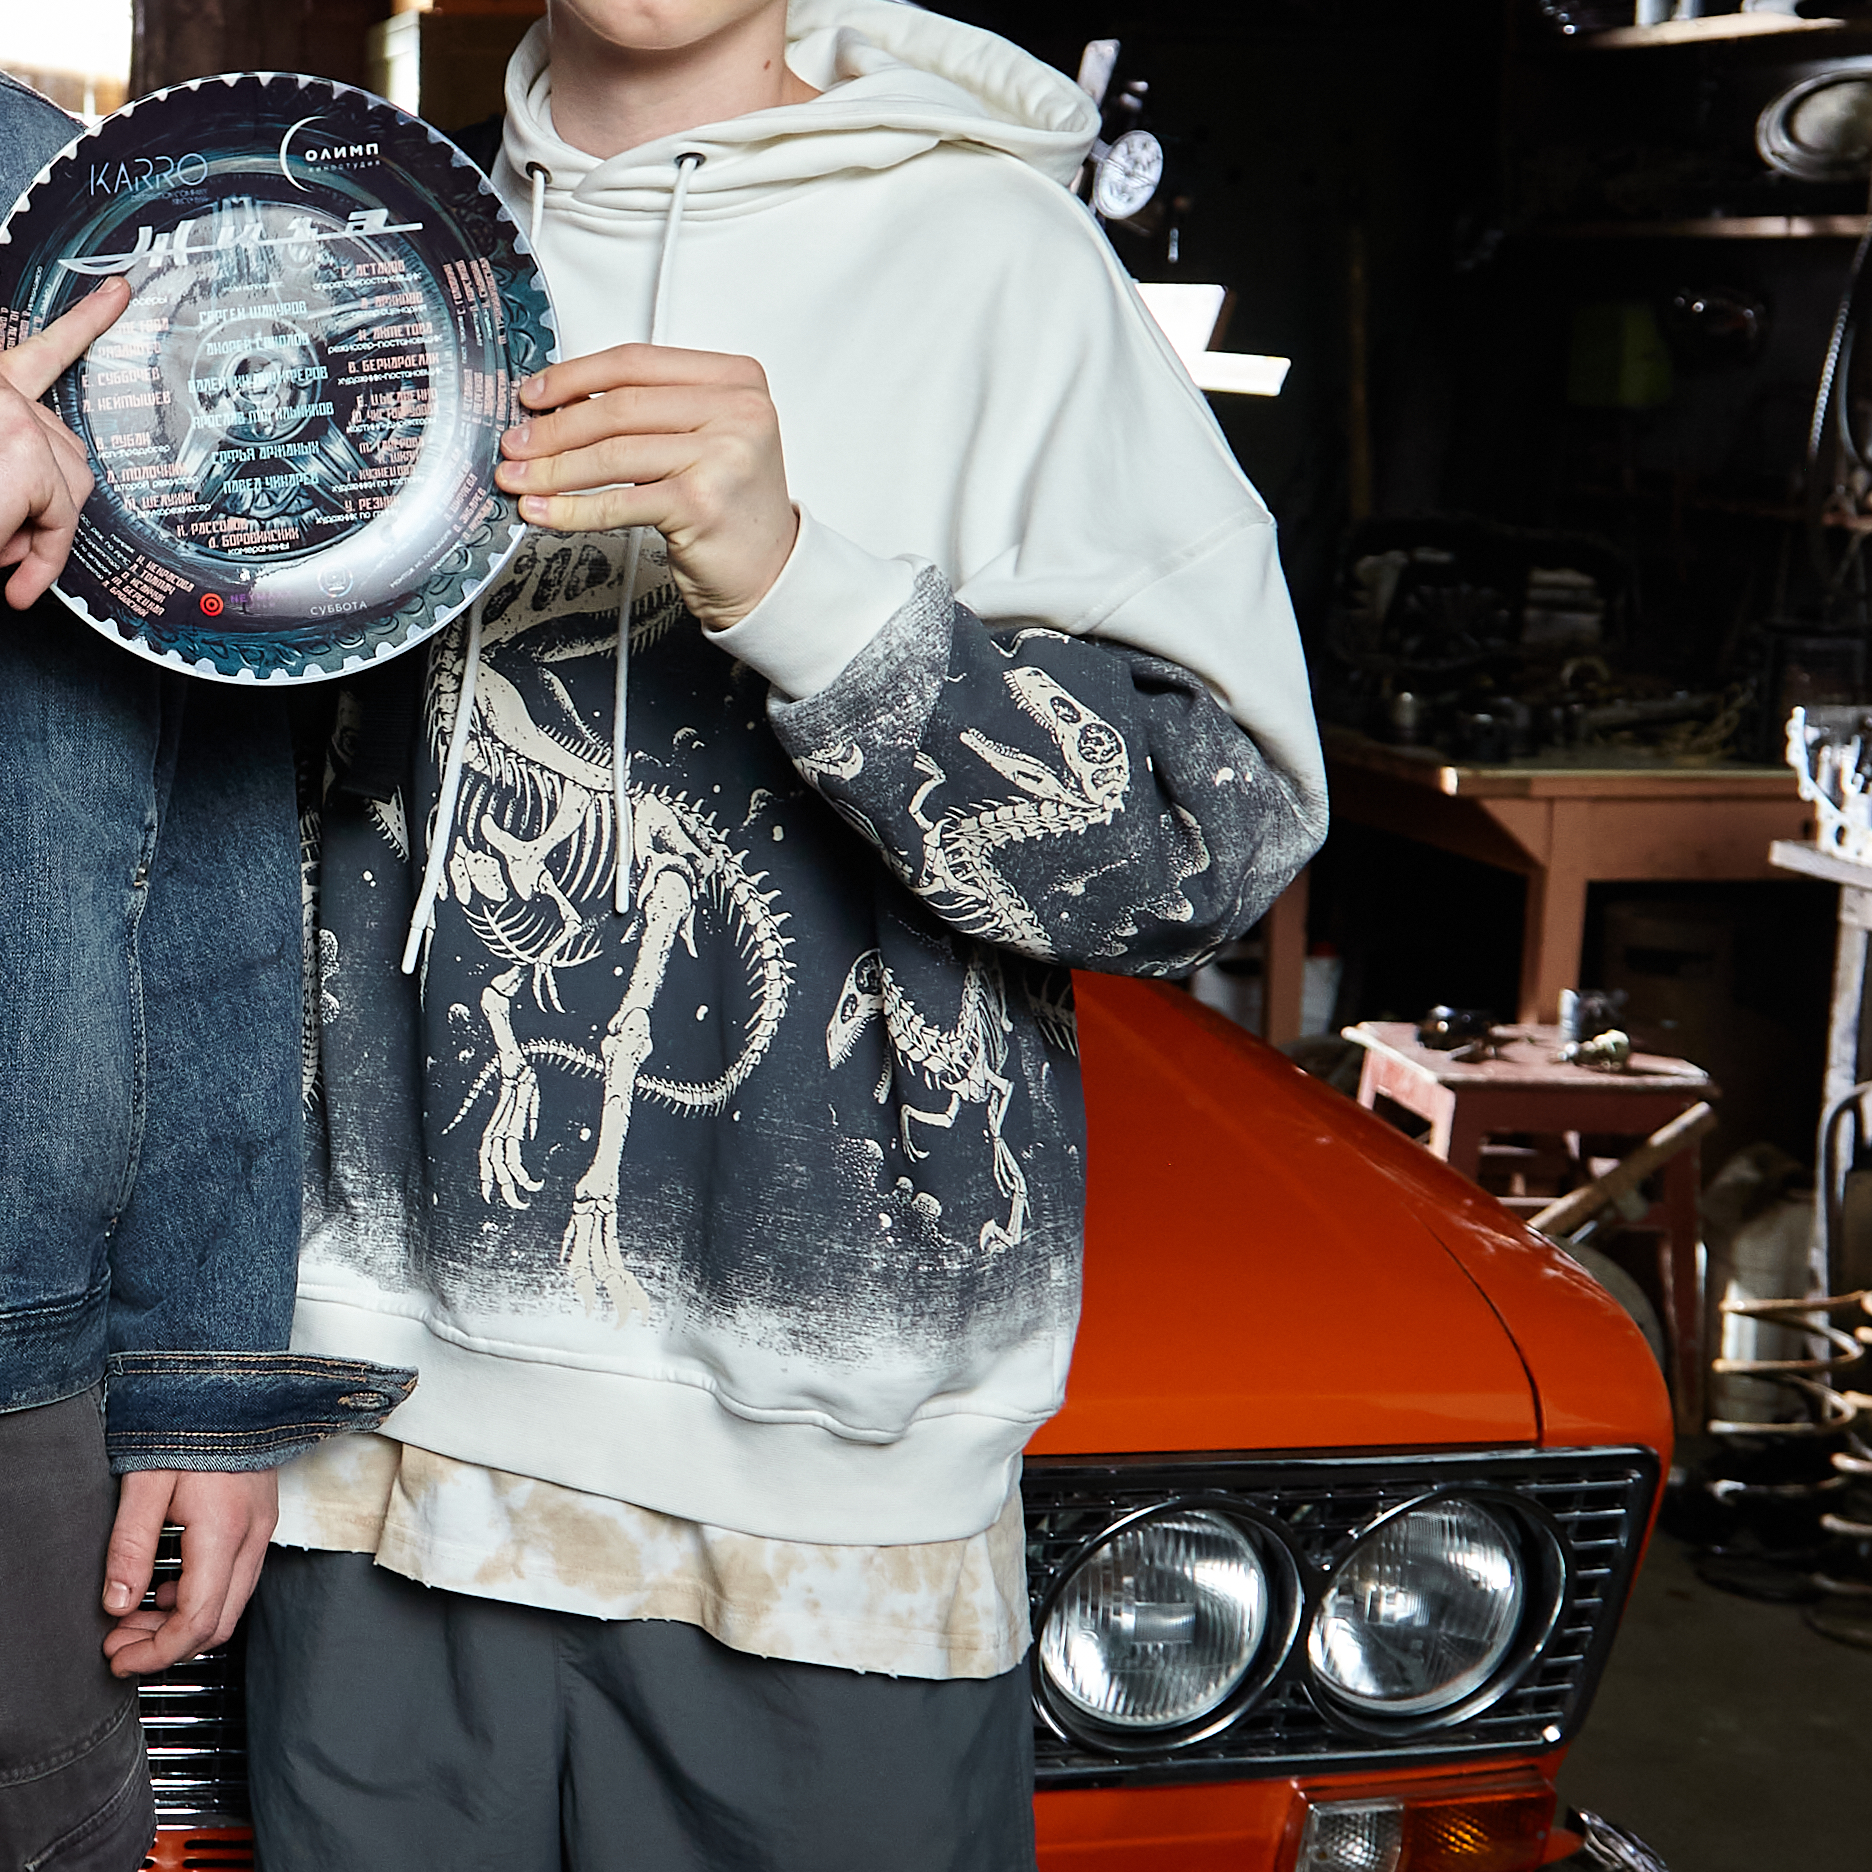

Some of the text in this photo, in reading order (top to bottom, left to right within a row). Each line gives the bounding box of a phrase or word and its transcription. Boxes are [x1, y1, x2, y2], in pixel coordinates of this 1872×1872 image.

[304, 142, 379, 163] ОЛИМП
[90, 153, 208, 195] KARRO
[199, 300, 307, 326] СЕРГЕЙ ШАКУРОВ
[206, 335, 252, 356] АНДРЕЙ
[191, 401, 335, 430] ЯРОСЛАВ МОГИЛЬНИКОВ
[111, 431, 151, 448] РУБАН
[212, 440, 320, 465] СОФЬЯ АРЖАНЫХ
[113, 481, 151, 493] второй
[223, 471, 320, 494] ПАВЕЛ ЧИНАРЕВ
[377, 479, 389, 488] по
[191, 517, 249, 536] РАССОЛОВ
[221, 526, 300, 547] БОРОВИНСКИХ
[140, 569, 177, 596] ТОЛМАЧ
[145, 559, 196, 593] НЕКРАСОВА
[310, 600, 368, 616] СУББОТА
